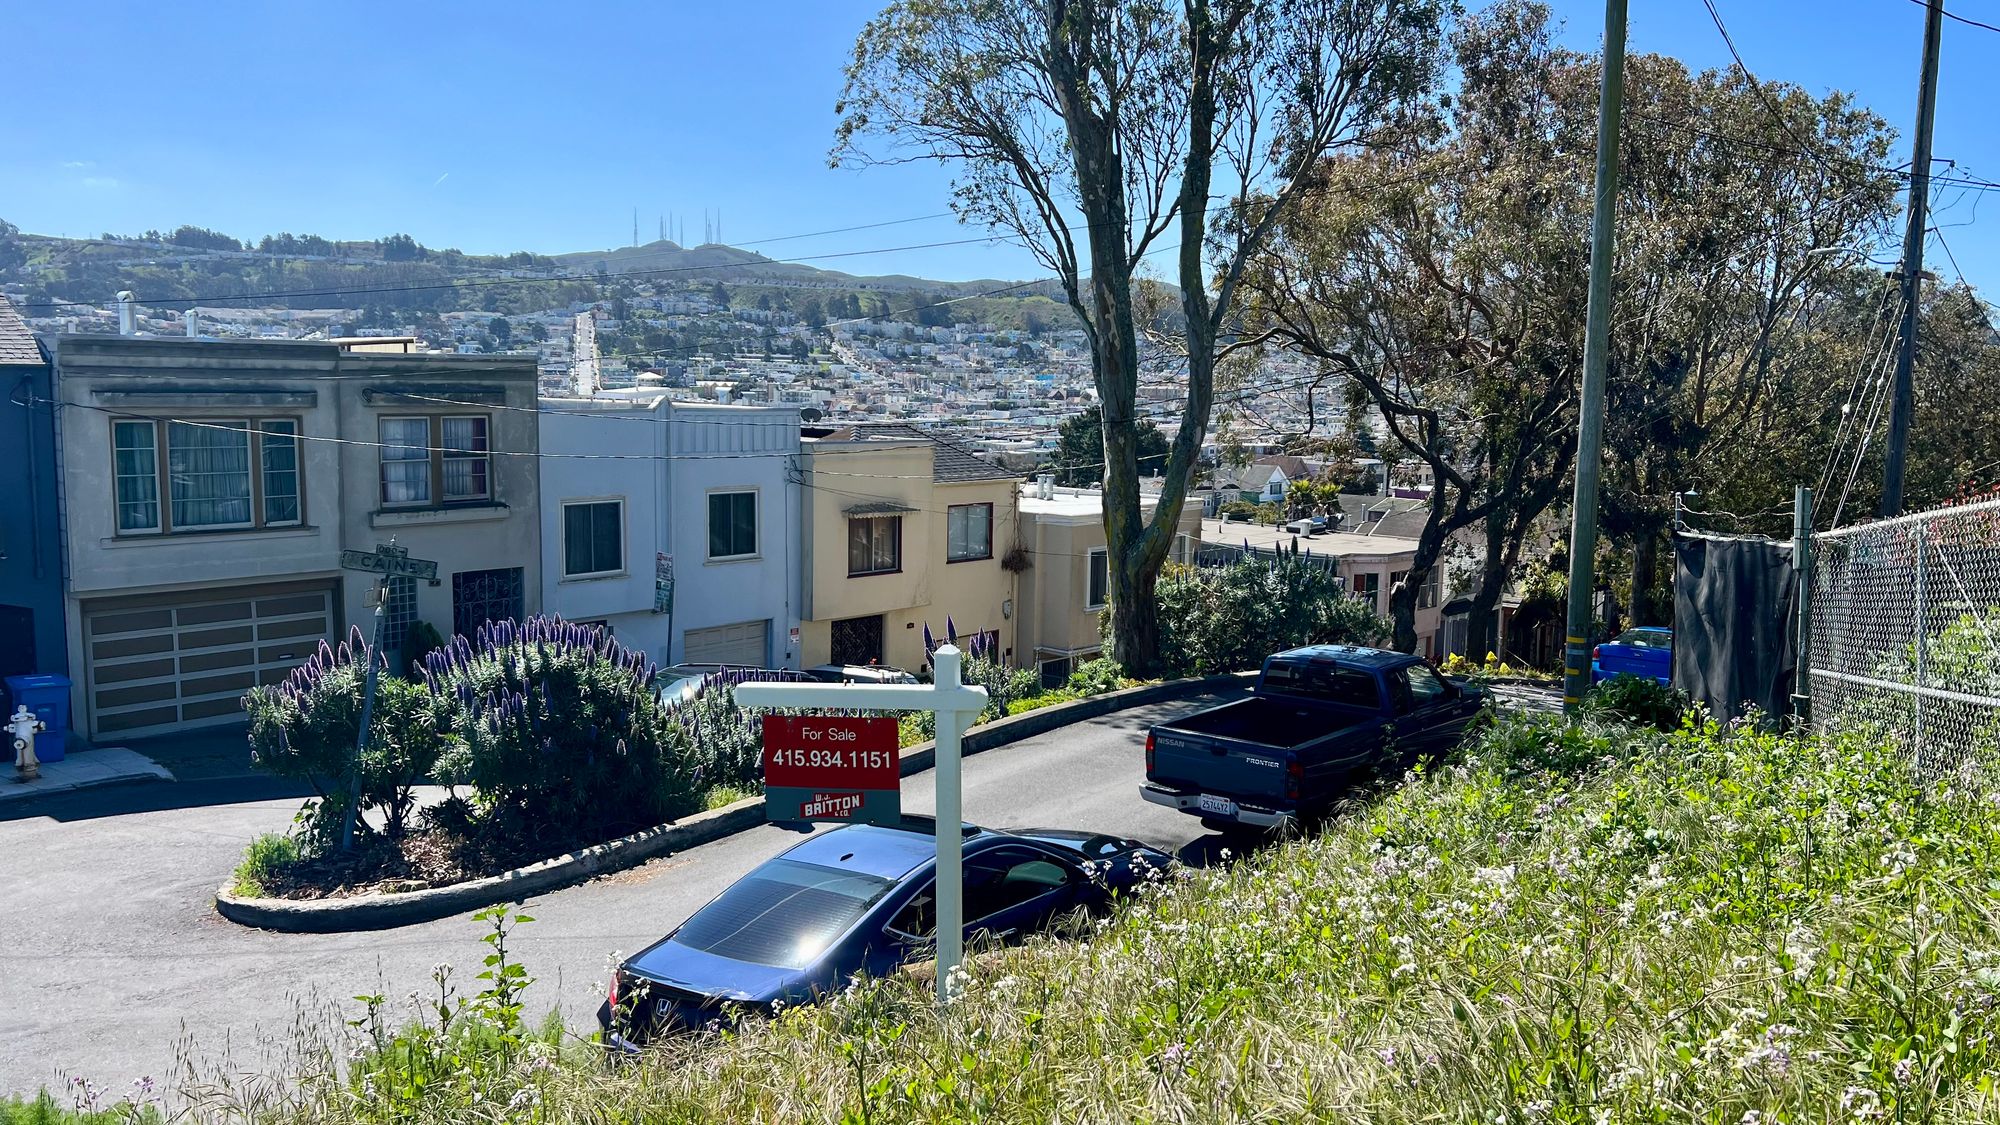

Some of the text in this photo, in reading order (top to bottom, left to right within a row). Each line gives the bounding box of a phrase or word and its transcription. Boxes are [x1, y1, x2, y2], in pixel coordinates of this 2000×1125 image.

[802, 727, 856, 741] For Sale
[1157, 737, 1185, 748] NISSAN
[773, 749, 890, 769] 415.934.1151
[1245, 757, 1280, 768] FRONTIER
[815, 794, 831, 802] W.J.
[804, 795, 860, 817] BRITTON
